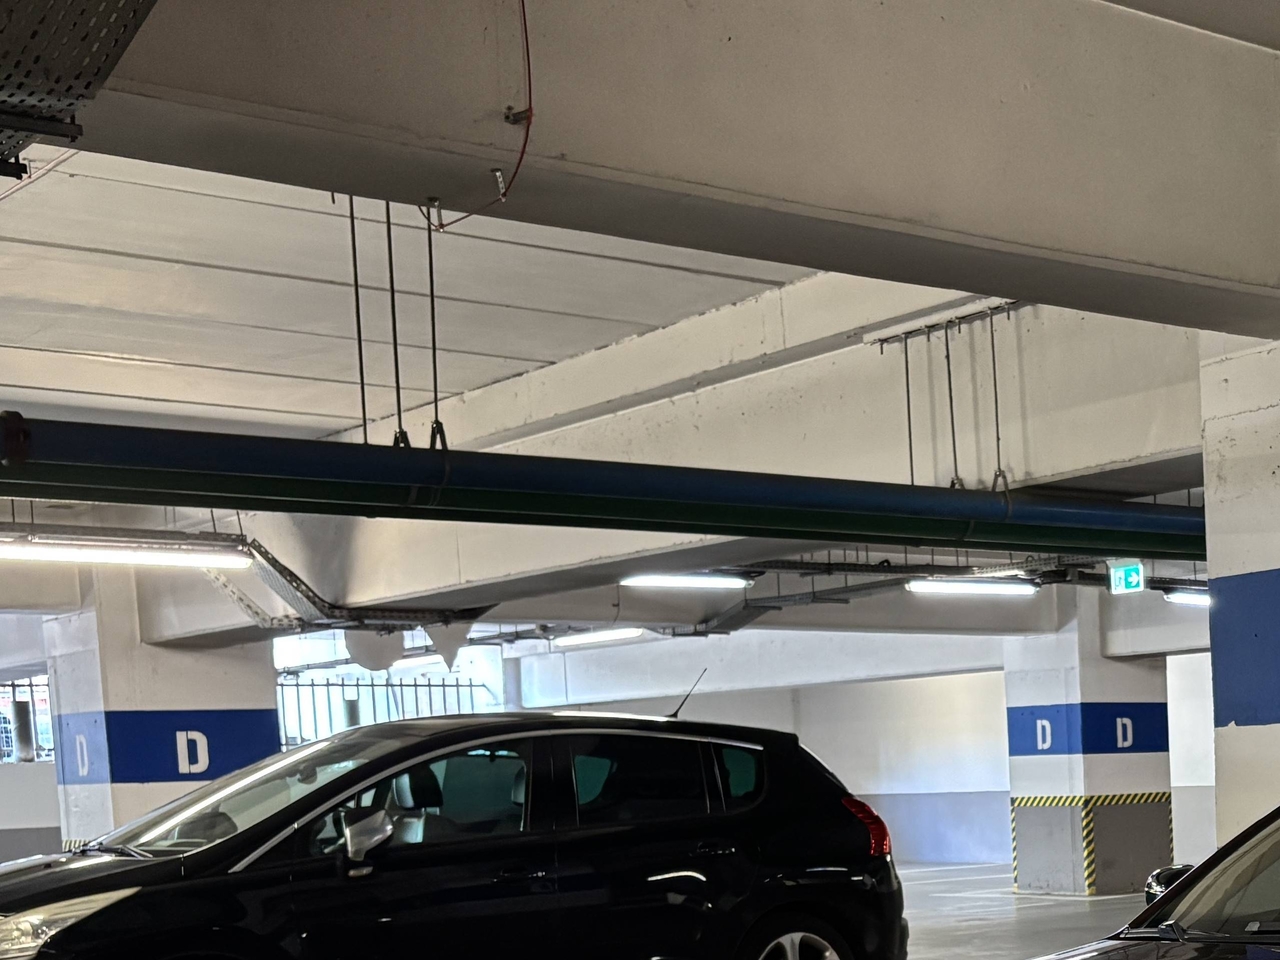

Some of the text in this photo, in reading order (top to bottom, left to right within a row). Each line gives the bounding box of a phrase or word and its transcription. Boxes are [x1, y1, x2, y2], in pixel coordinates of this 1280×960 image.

[1036, 719, 1052, 750] D
[1116, 717, 1133, 748] D
[76, 734, 89, 777] D
[176, 730, 210, 774] D
